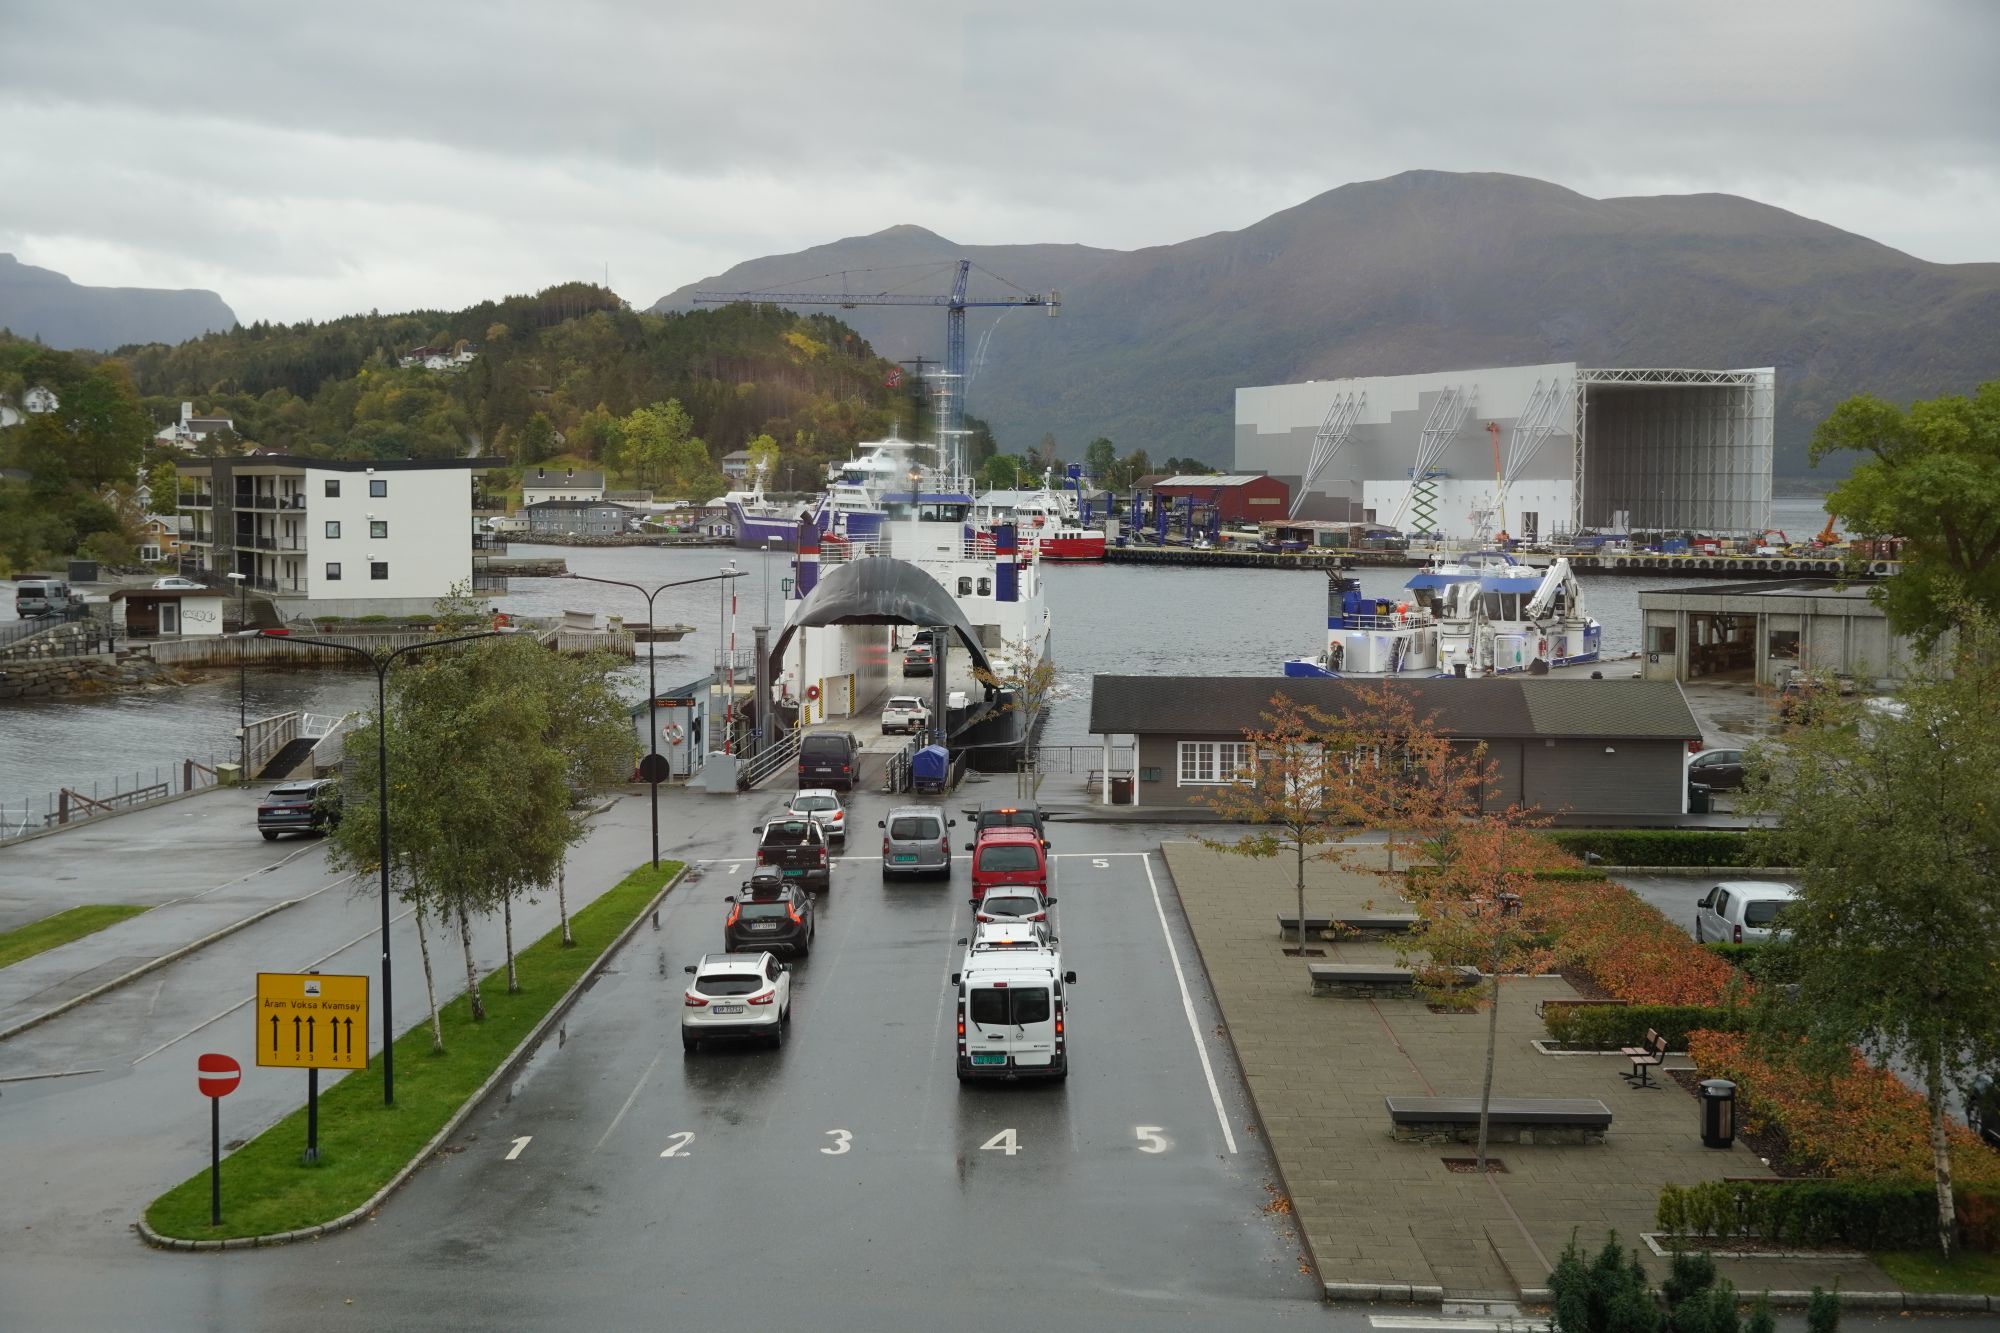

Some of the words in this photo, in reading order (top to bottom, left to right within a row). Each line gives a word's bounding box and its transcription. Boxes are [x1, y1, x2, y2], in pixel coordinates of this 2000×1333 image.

[728, 863, 741, 874] 1
[1092, 858, 1109, 868] 5
[264, 998, 287, 1008] Åram
[291, 1000, 318, 1009] Voksa
[322, 1001, 361, 1012] Kvamsøy
[505, 1135, 533, 1160] 1
[659, 1131, 696, 1158] 2
[820, 1129, 853, 1155] 3
[979, 1128, 1023, 1156] 4
[1136, 1126, 1167, 1154] 5
